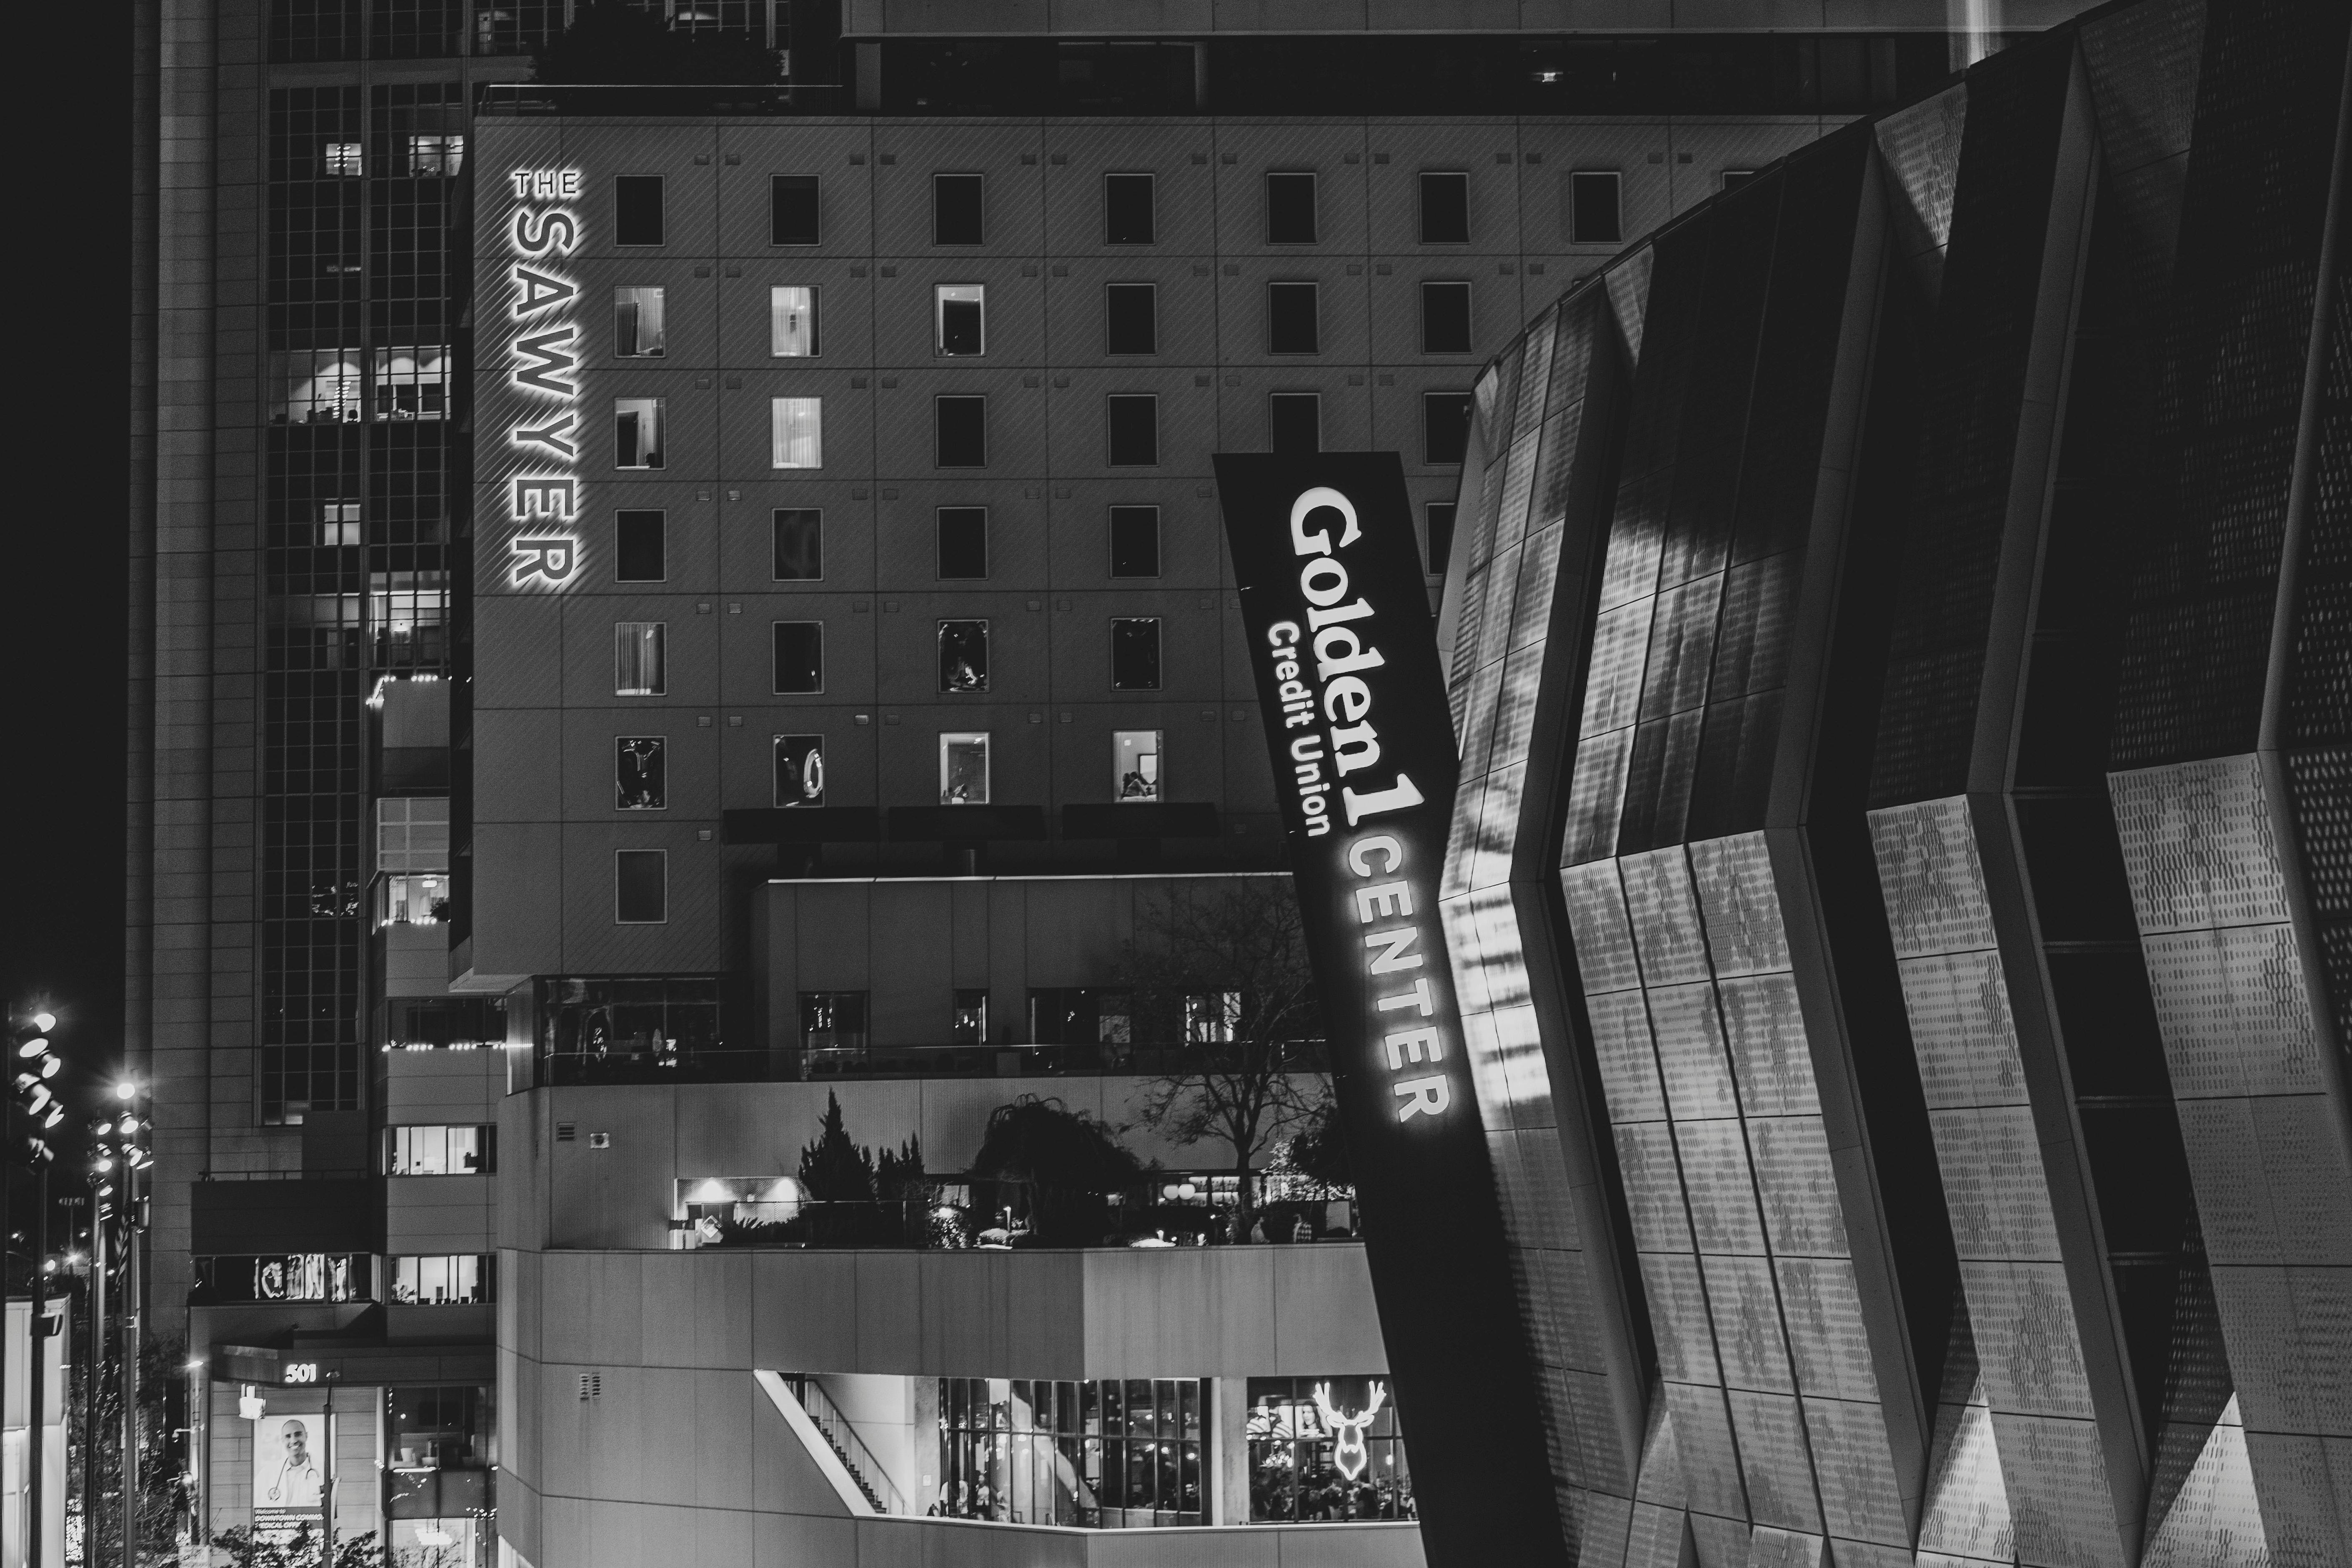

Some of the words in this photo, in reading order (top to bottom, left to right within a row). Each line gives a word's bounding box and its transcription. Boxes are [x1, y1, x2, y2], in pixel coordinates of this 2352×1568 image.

[514, 172, 577, 195] THE
[516, 211, 575, 583] SAWYER
[1268, 621, 1315, 728] Credit
[1290, 487, 1385, 778] Golden
[1290, 735, 1331, 837] Union
[1342, 773, 1425, 827] 1
[1349, 835, 1451, 1123] CENTER
[285, 1363, 317, 1383] 501
